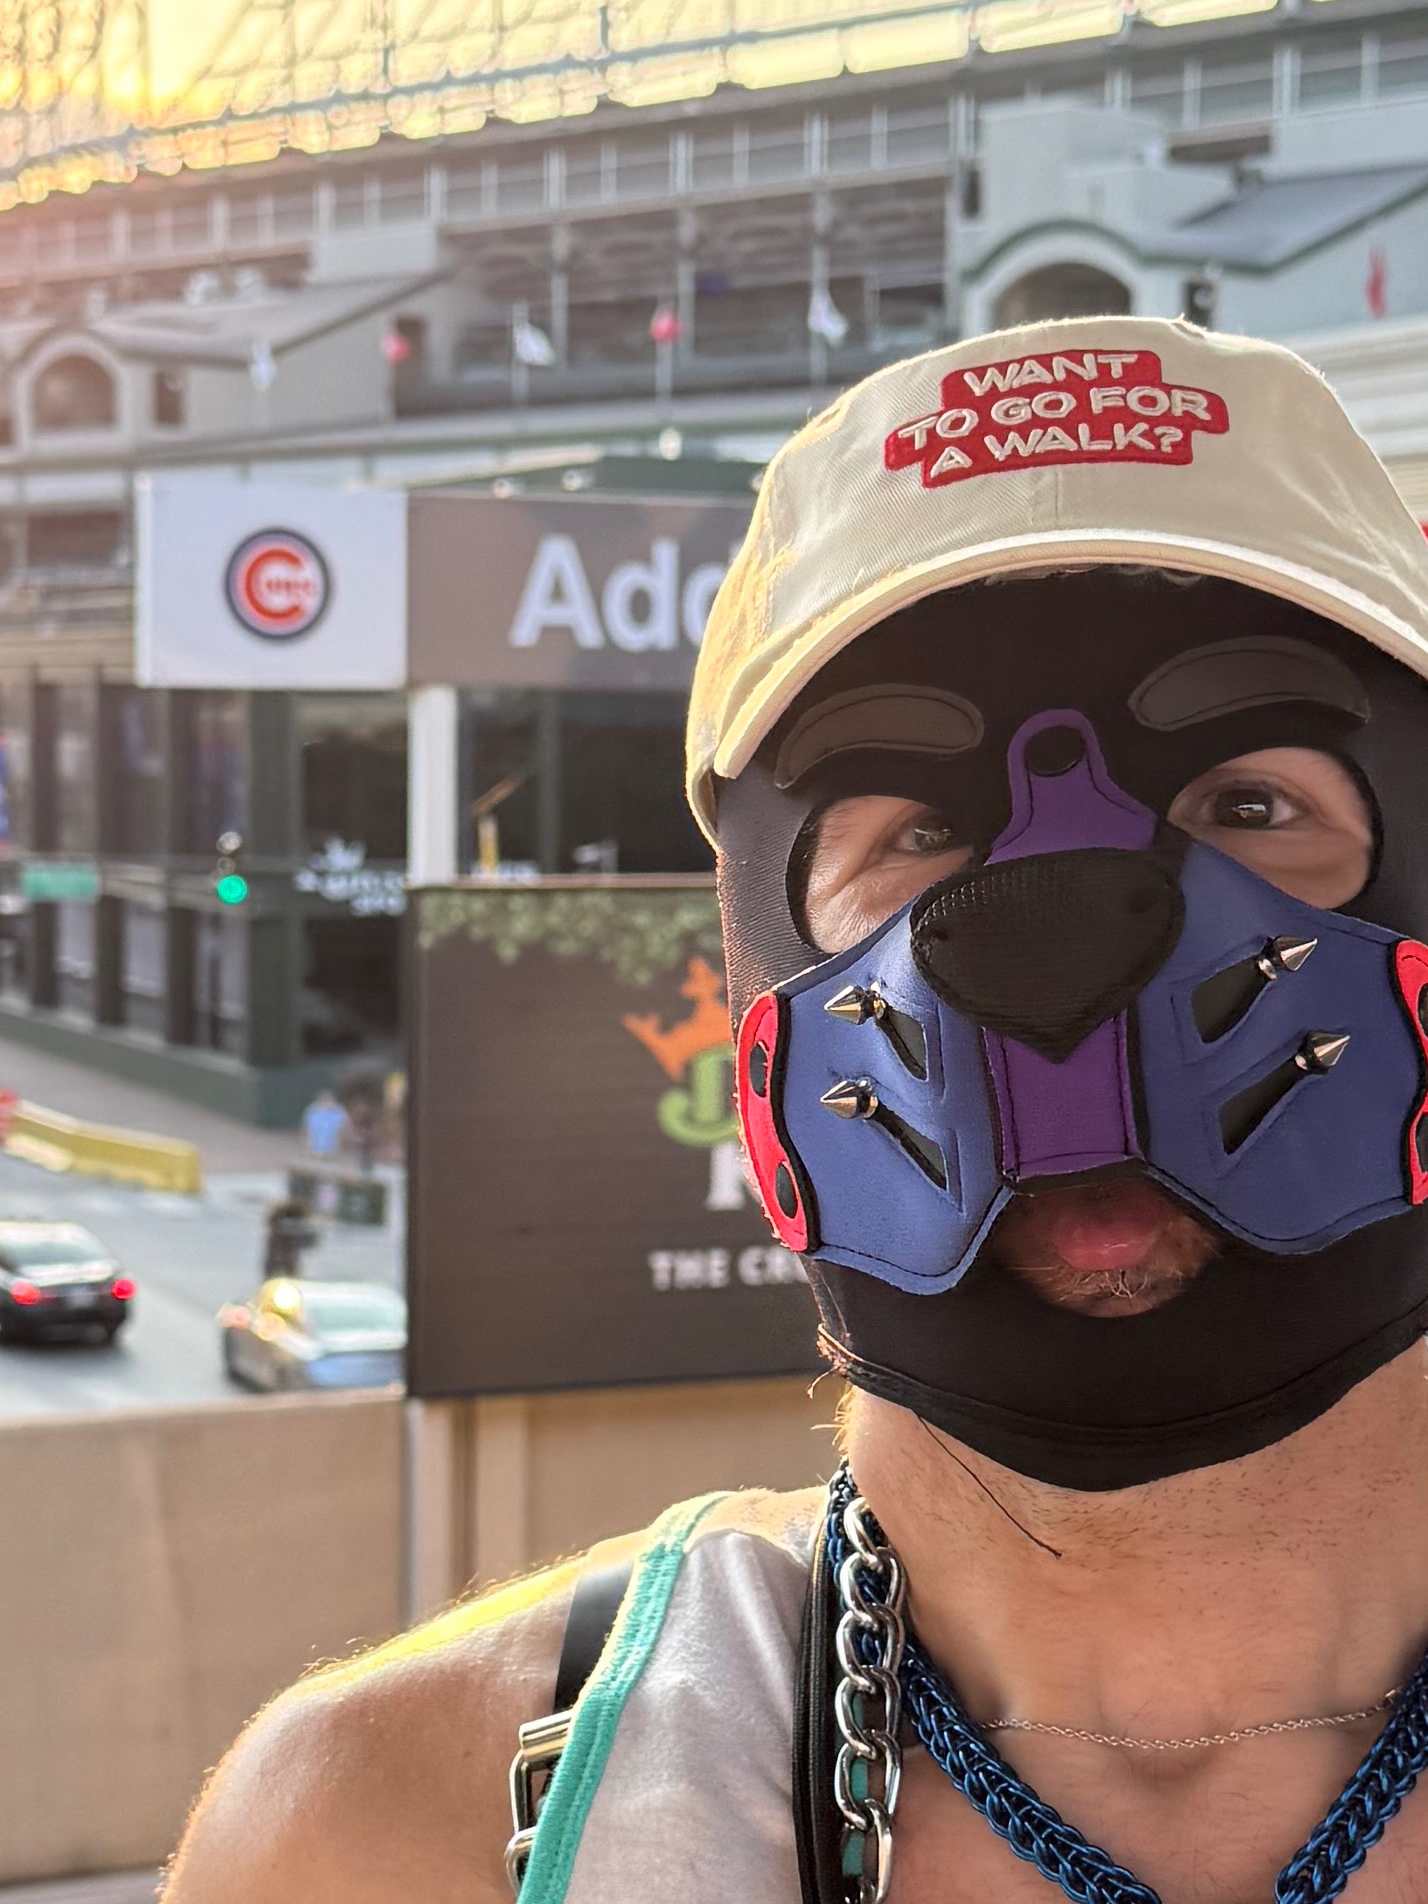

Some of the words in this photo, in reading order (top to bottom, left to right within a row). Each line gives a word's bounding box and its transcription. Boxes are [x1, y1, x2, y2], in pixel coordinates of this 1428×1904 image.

[963, 353, 1139, 396] WANT
[898, 408, 979, 450] TO
[990, 390, 1077, 425] GO
[1089, 385, 1212, 421] FOR
[930, 445, 973, 479] A
[984, 422, 1184, 462] WALK?
